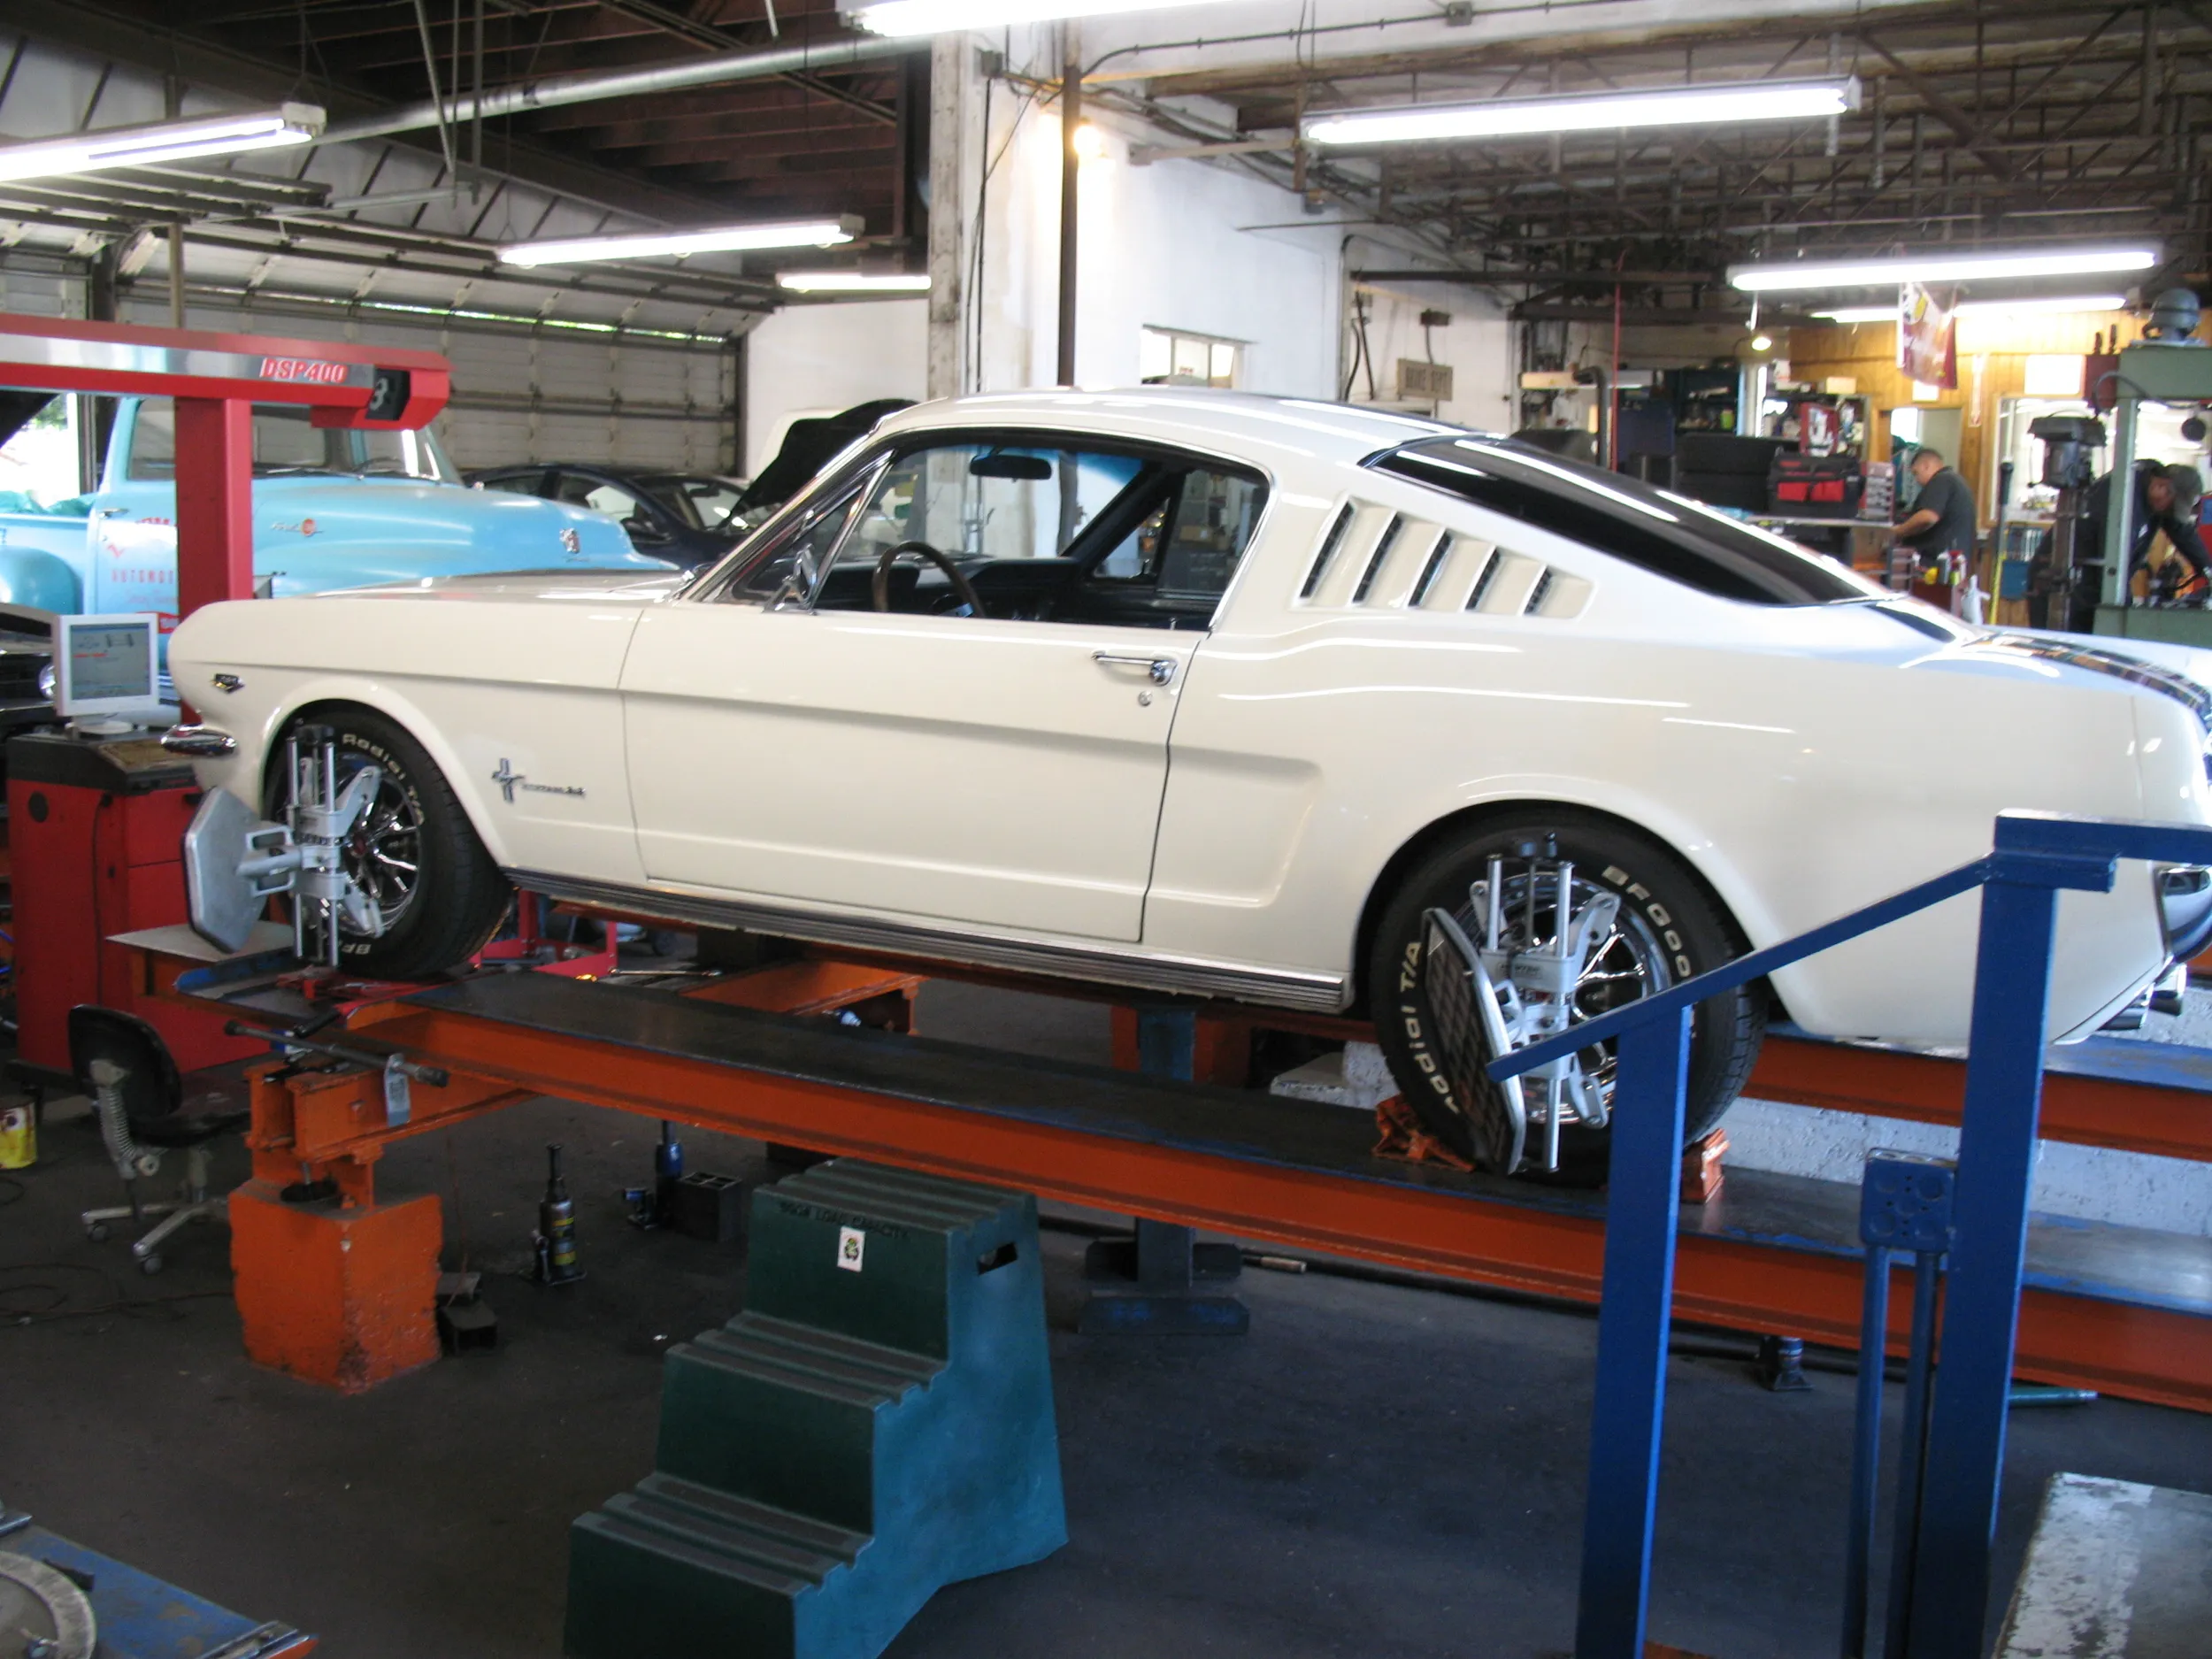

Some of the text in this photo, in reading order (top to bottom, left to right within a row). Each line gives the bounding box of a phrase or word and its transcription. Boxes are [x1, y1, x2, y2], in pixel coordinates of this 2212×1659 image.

[258, 357, 349, 384] DSP400
[342, 733, 407, 780] Radial
[1399, 941, 1422, 993] T/A
